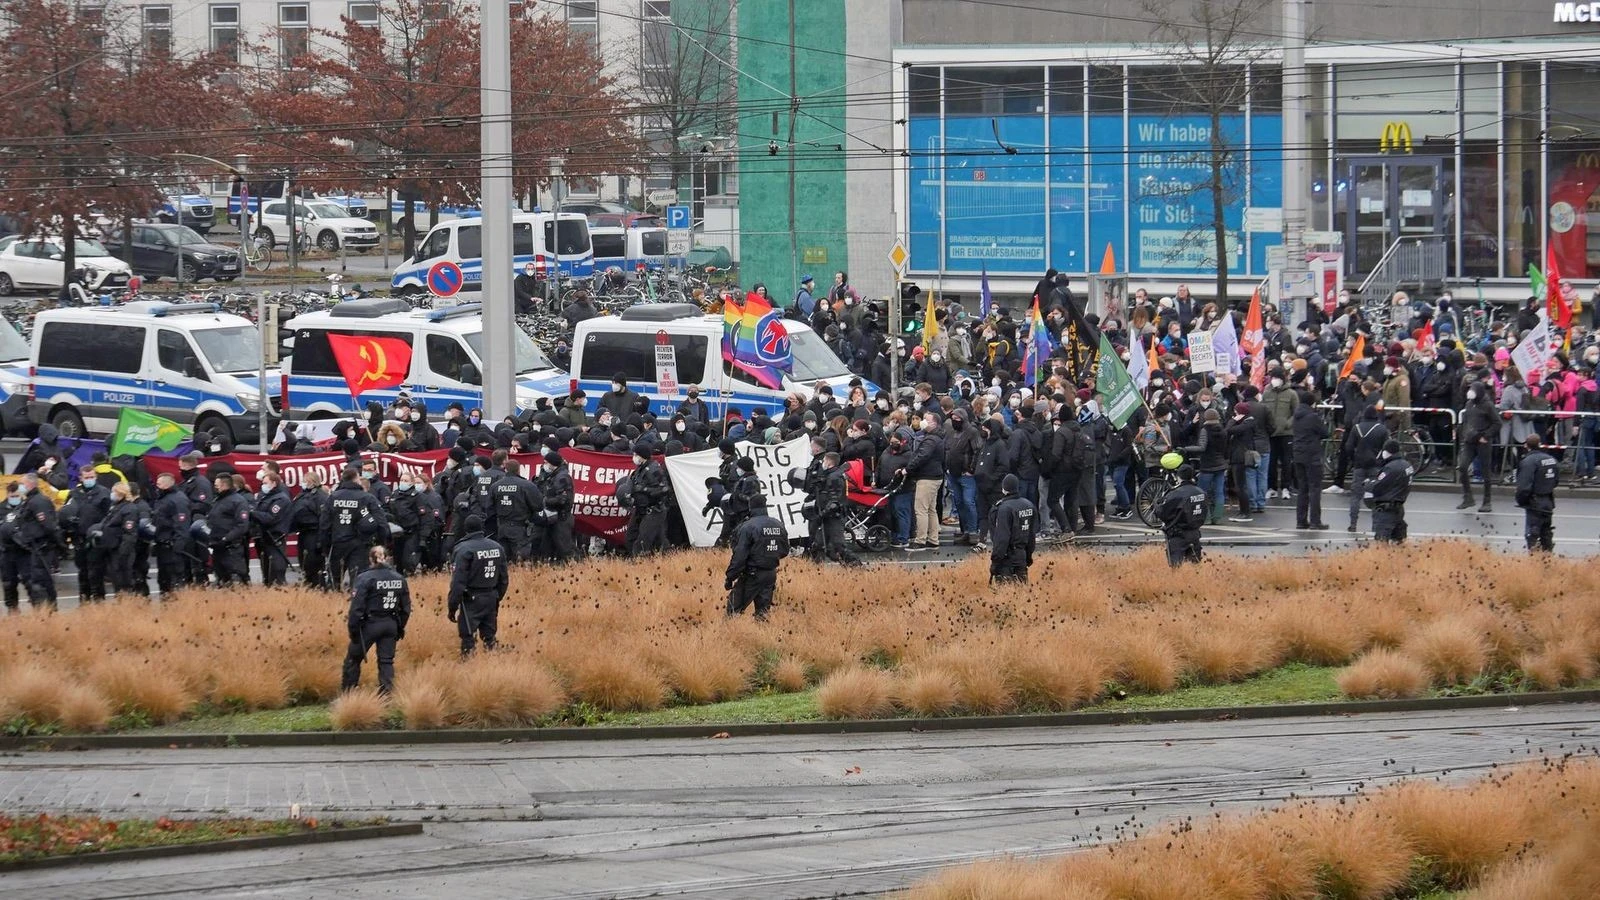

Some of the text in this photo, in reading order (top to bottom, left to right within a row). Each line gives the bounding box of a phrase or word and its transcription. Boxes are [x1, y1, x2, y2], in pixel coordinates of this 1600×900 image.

[1138, 124, 1212, 142] Wir habe
[1139, 152, 1161, 169] die
[672, 209, 684, 227] P
[1140, 205, 1195, 223] für Sie!
[1143, 236, 1160, 247] Dies
[952, 247, 1041, 258] IHR EINKAUFSBAHNHOF
[1191, 345, 1211, 354] GEGEN
[1191, 353, 1212, 361] RECHTS
[104, 392, 135, 403] POLIZEI
[498, 484, 517, 493] POLIZEI
[334, 499, 359, 509] POLIZEI
[1018, 508, 1034, 519] POLIZEI
[763, 527, 781, 536] POLIZEI
[477, 548, 501, 560] POLIZEI
[376, 580, 403, 590] POLIZEI
